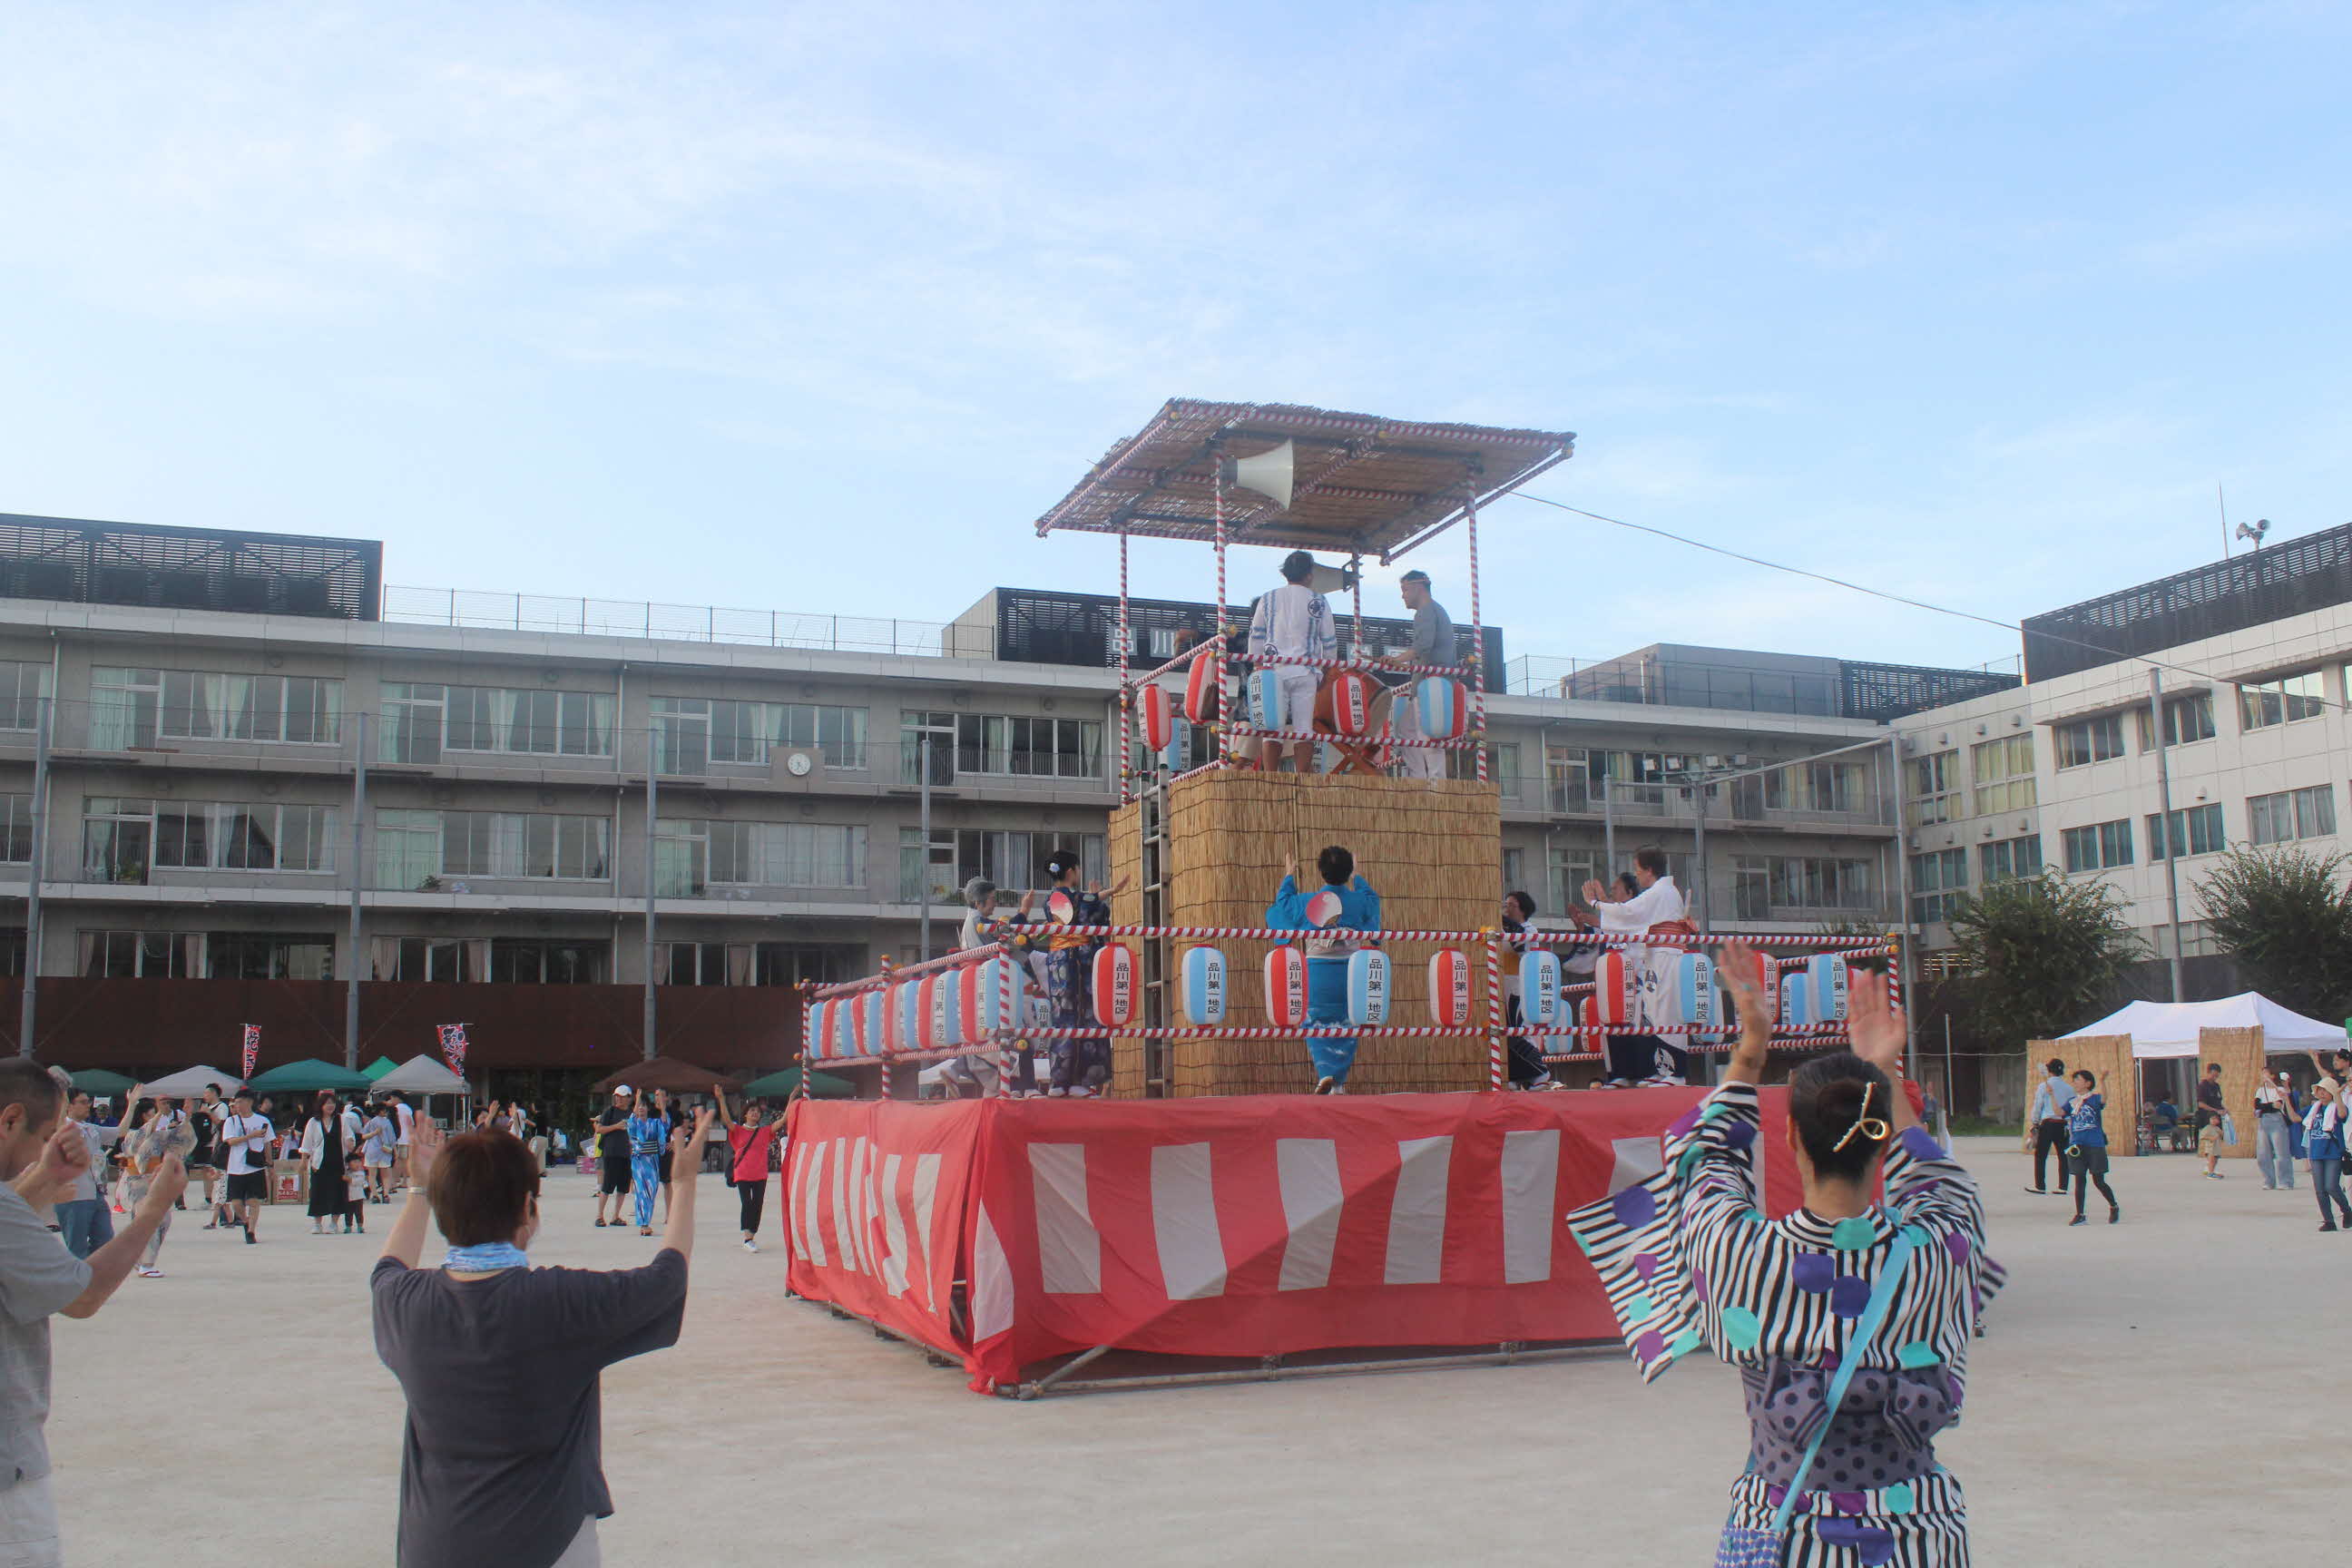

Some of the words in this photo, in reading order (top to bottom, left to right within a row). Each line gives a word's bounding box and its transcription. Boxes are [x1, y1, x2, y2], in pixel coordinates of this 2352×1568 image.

[1250, 674, 1264, 728] 品川第一地区
[1350, 684, 1364, 726] 品川第一地区
[1114, 962, 1130, 1014] 品川第一地区
[1208, 962, 1220, 1014] 品川第一地区
[1289, 961, 1302, 1016] 品川第一地区
[1367, 958, 1383, 1022] 品川第一地区
[1454, 960, 1467, 1021] 品川第一地区
[1541, 965, 1553, 1014] 品川第一地区
[1624, 961, 1634, 1022] 品川第一地区
[1695, 962, 1709, 1021] 品川第一地区
[1833, 962, 1845, 1018] 品川第一地区
